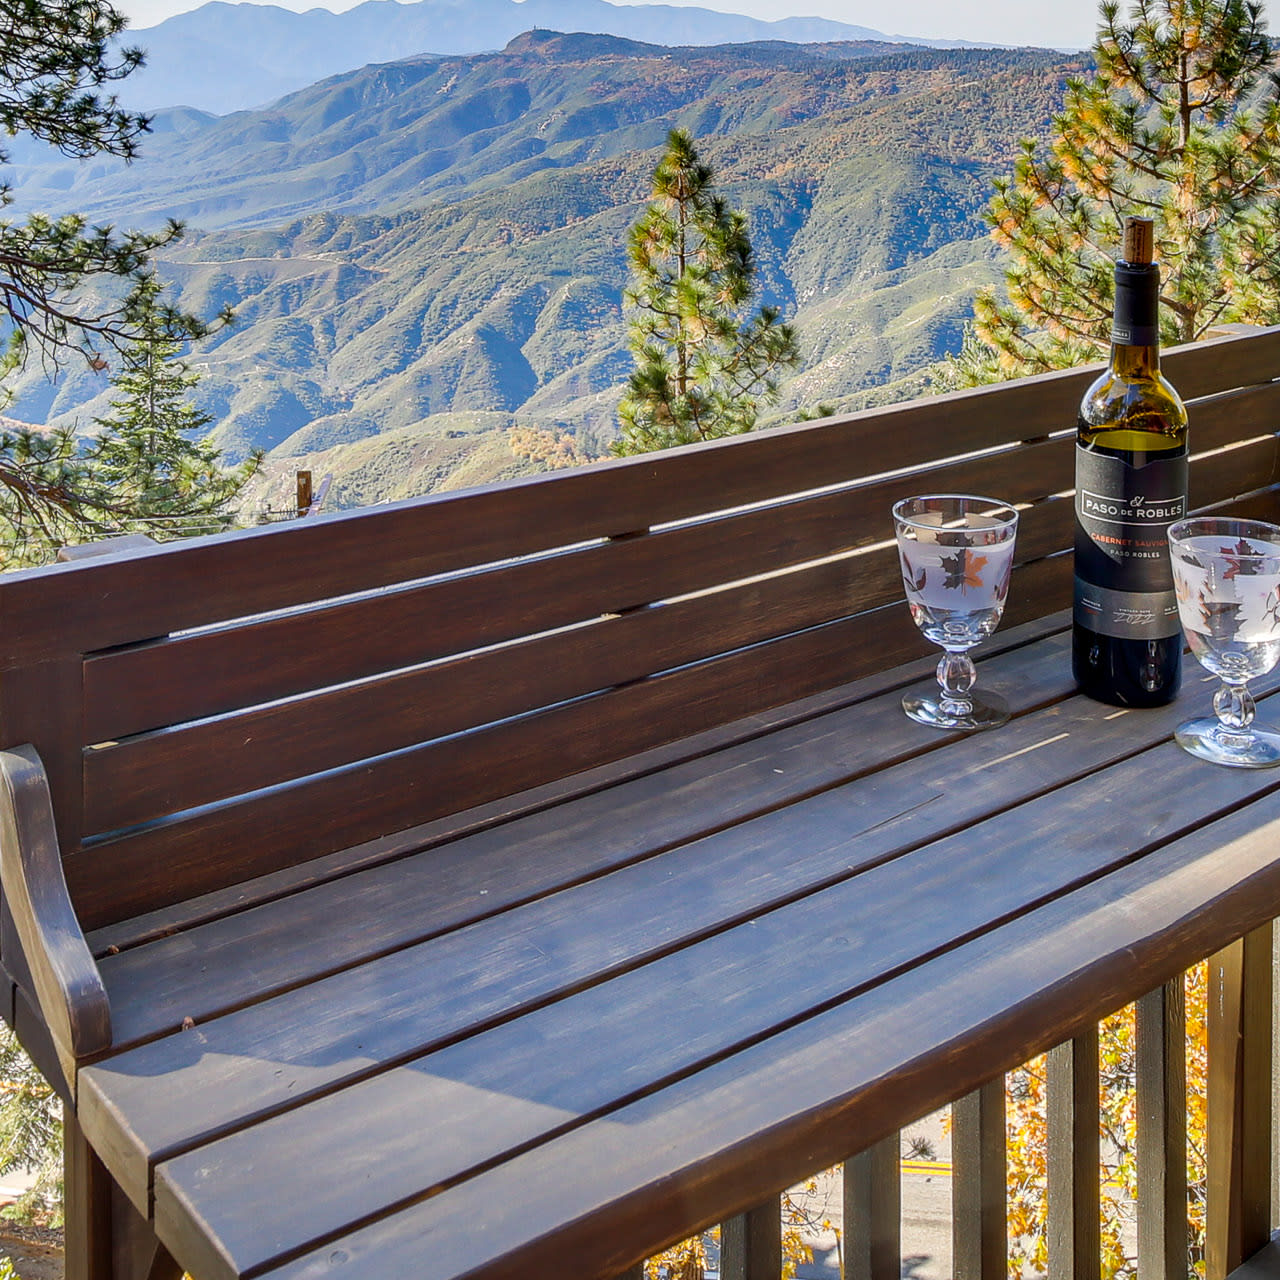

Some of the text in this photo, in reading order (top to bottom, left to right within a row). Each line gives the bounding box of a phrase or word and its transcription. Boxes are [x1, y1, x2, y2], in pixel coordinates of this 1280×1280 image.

[1129, 495, 1145, 507] El
[1086, 499, 1182, 518] PASO DE ROBLES
[1090, 532, 1132, 546] CABERNET
[1110, 549, 1130, 557] PASO
